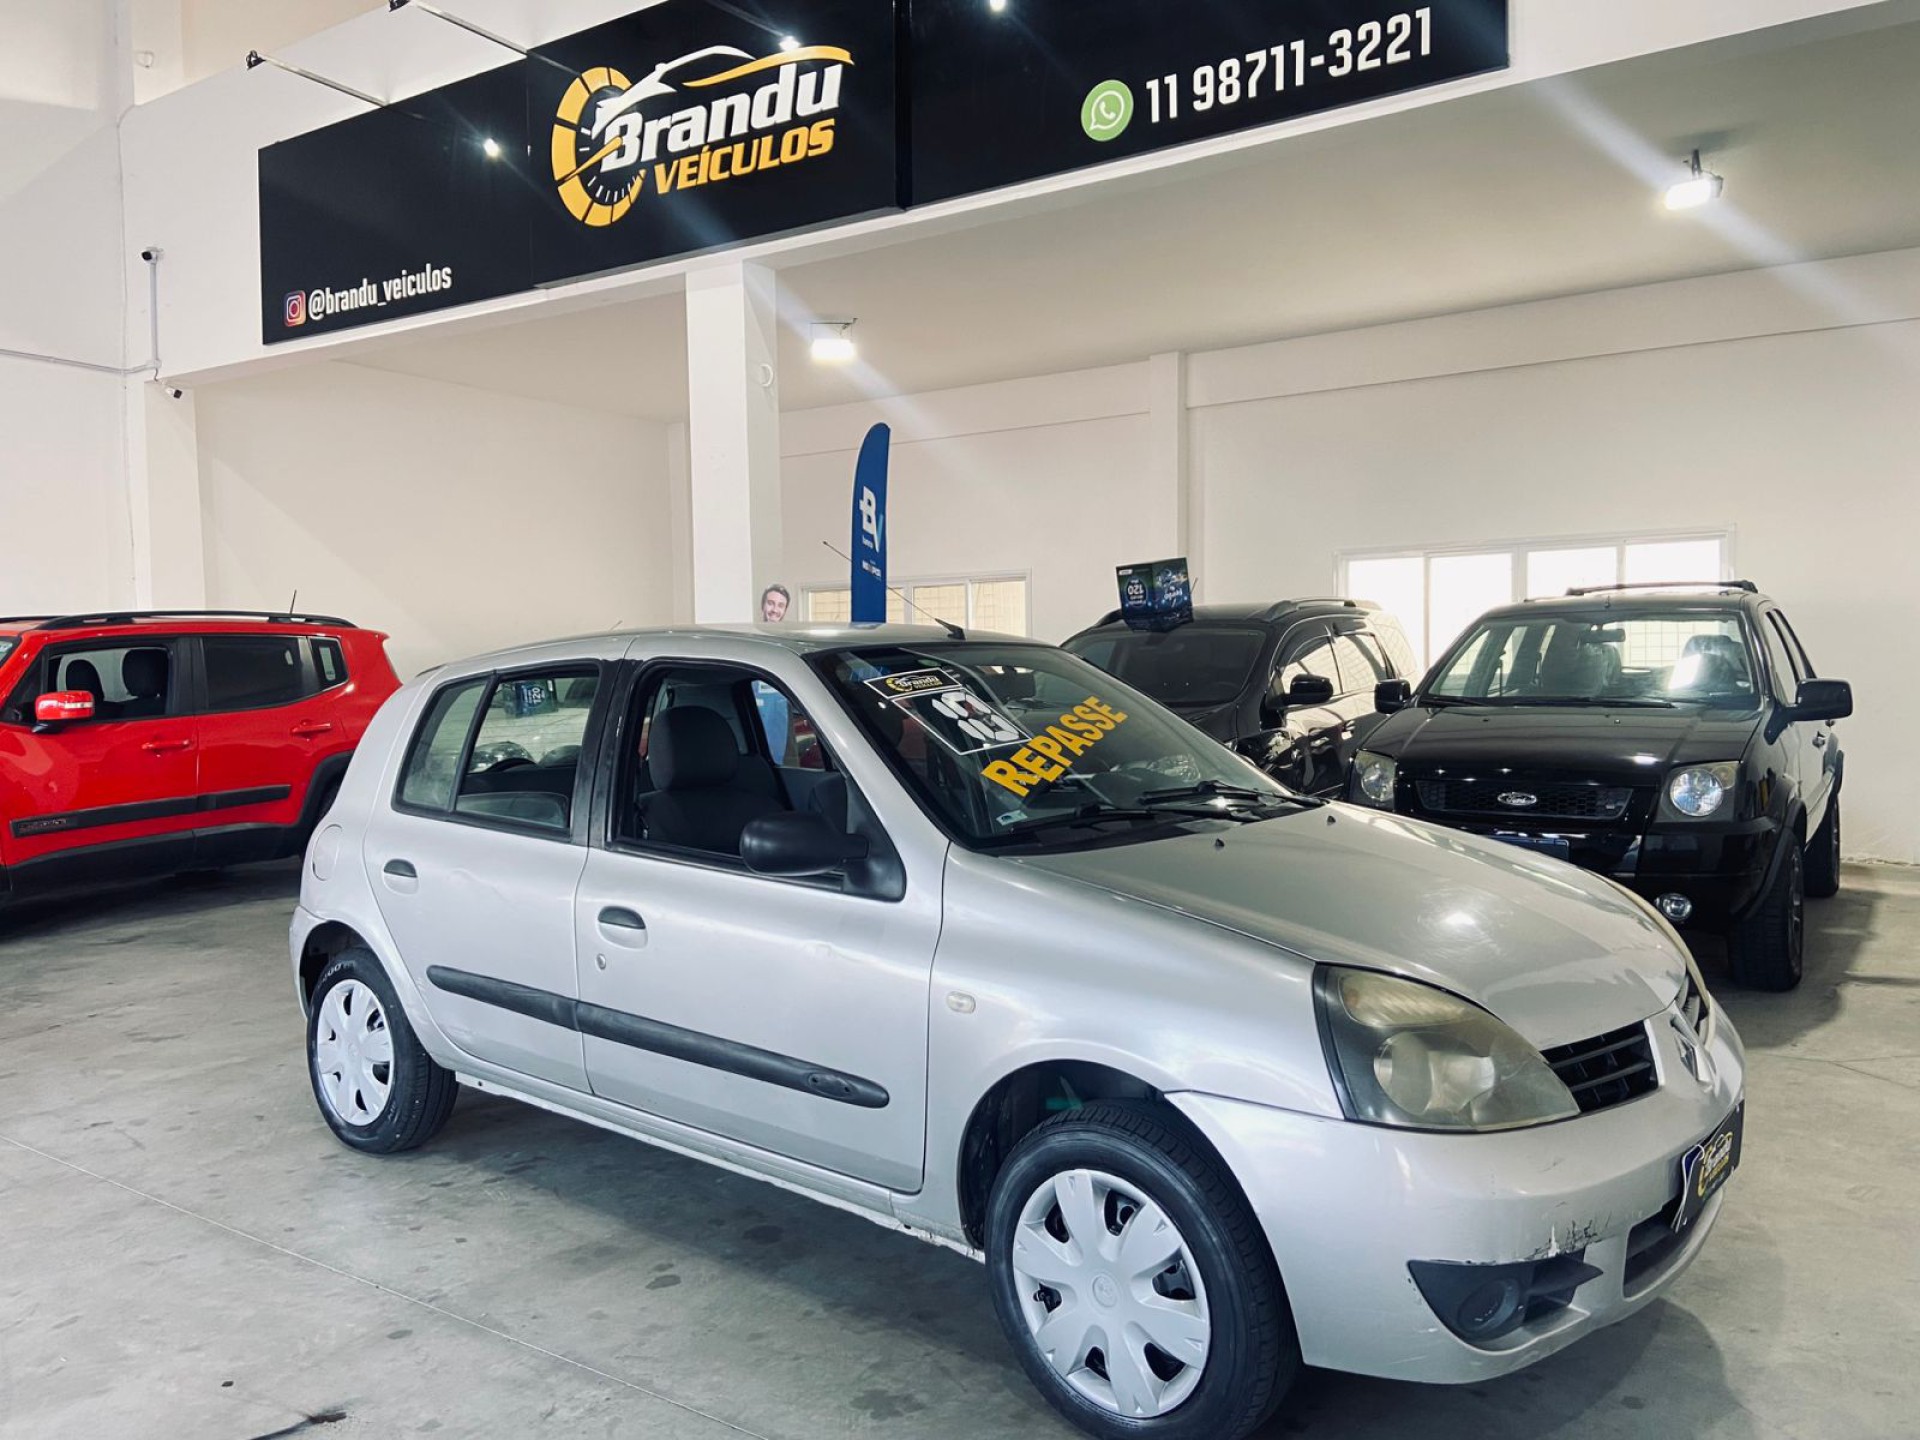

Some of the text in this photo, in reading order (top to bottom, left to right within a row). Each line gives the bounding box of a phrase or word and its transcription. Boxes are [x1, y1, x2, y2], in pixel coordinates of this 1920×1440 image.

[1146, 7, 1431, 122] 11 98711-3221
[592, 62, 843, 173] Brandu
[654, 118, 835, 194] VEÍCULOS
[308, 263, 452, 320] @brandu_veiculos
[980, 696, 1128, 797] REPASSE
